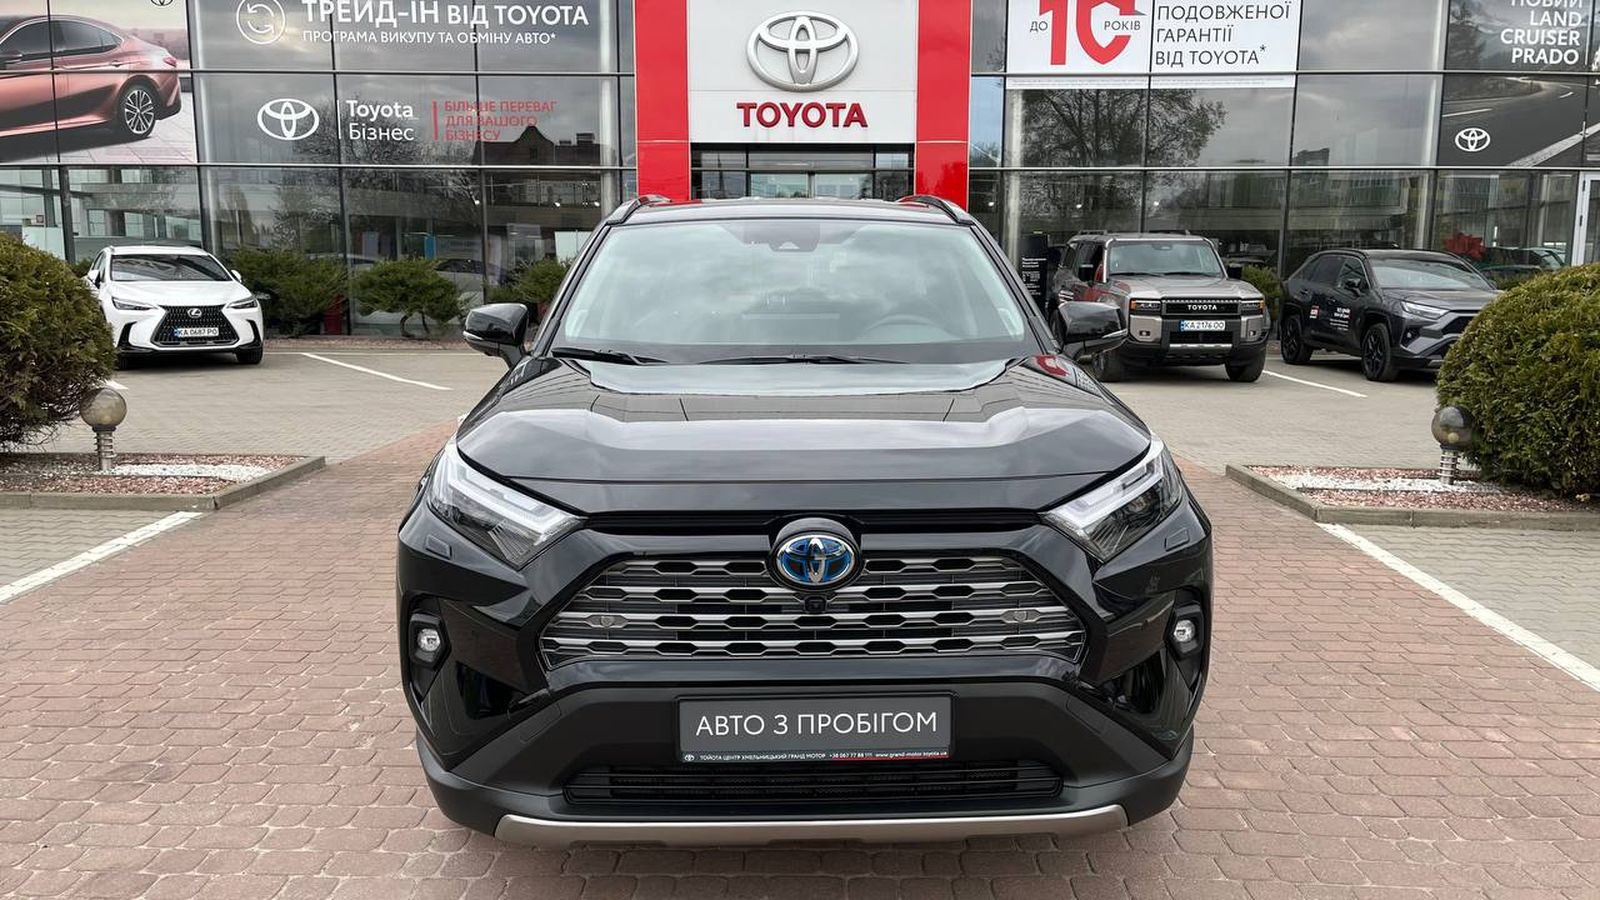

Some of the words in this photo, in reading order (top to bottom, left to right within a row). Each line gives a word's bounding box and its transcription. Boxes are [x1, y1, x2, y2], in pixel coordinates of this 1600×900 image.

[447, 4, 489, 29] ВІД
[494, 5, 589, 26] TOYOTA
[1158, 1, 1292, 23] ПОДОВЖЕНОЇ
[1530, 10, 1582, 27] LAND
[1030, 20, 1048, 32] ДО
[1103, 20, 1141, 31] РОКІВ
[1157, 24, 1234, 43] ГАРАНТІЇ
[303, 30, 377, 43] ПРОГРАМА
[380, 31, 435, 44] ВИКУПУ
[438, 31, 454, 44] ТА
[457, 32, 512, 44] ОБМІНУ
[1500, 28, 1581, 46] CRUISER
[1155, 50, 1184, 68] ВІД
[1511, 47, 1579, 65] PRADO
[345, 99, 414, 121] Toyota
[444, 101, 497, 112] БІЛЬШЕ
[500, 101, 558, 112] ПЕРЕВАГ
[736, 101, 869, 129] TOYOTA
[444, 115, 476, 128] ДЛЯ
[479, 115, 538, 127] ВАШОГО
[349, 123, 414, 141] Бізнес
[444, 129, 501, 142] БІЗНЕСУ
[695, 715, 765, 736] АВТО
[773, 714, 789, 735] З
[797, 711, 937, 734] ПРОБІГОМ
